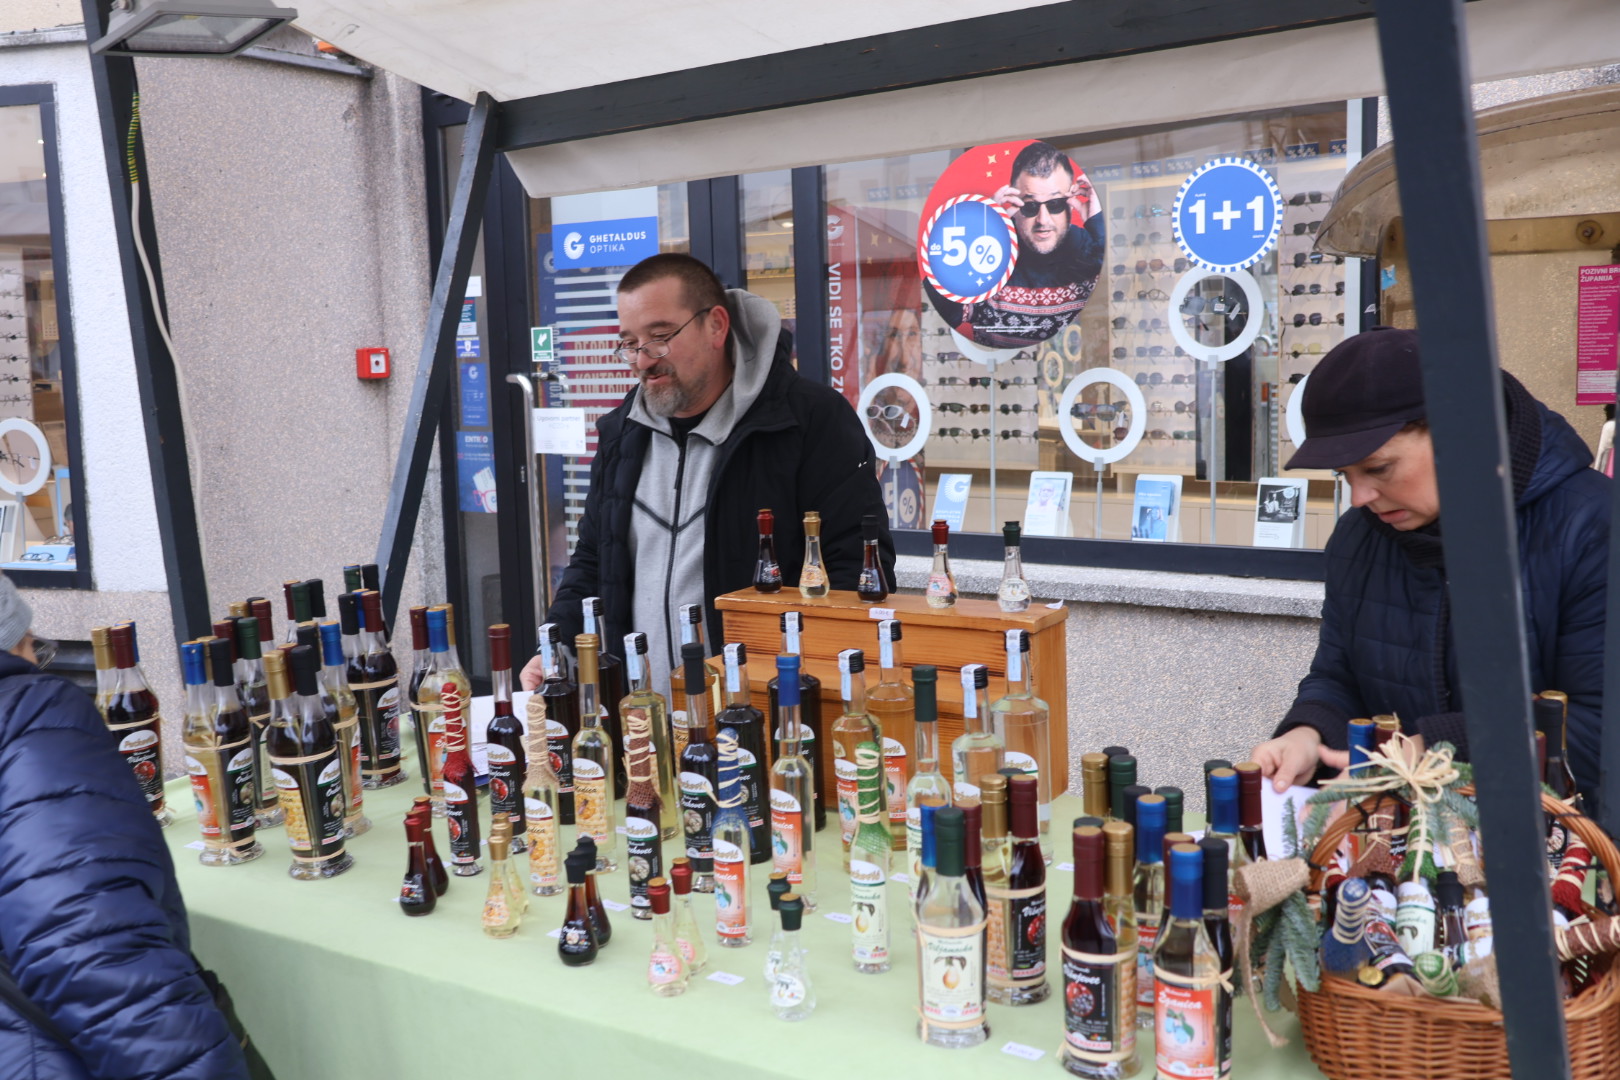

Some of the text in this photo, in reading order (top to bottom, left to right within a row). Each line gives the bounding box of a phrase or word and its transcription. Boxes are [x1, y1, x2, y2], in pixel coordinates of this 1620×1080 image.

[1188, 195, 1264, 235] 1+1
[589, 231, 647, 243] GHETALDUS
[589, 244, 625, 254] OPTIKA
[828, 262, 842, 300] VIDI
[1580, 267, 1608, 275] POZIVNI
[829, 306, 843, 329] SE
[830, 333, 844, 371] TKO
